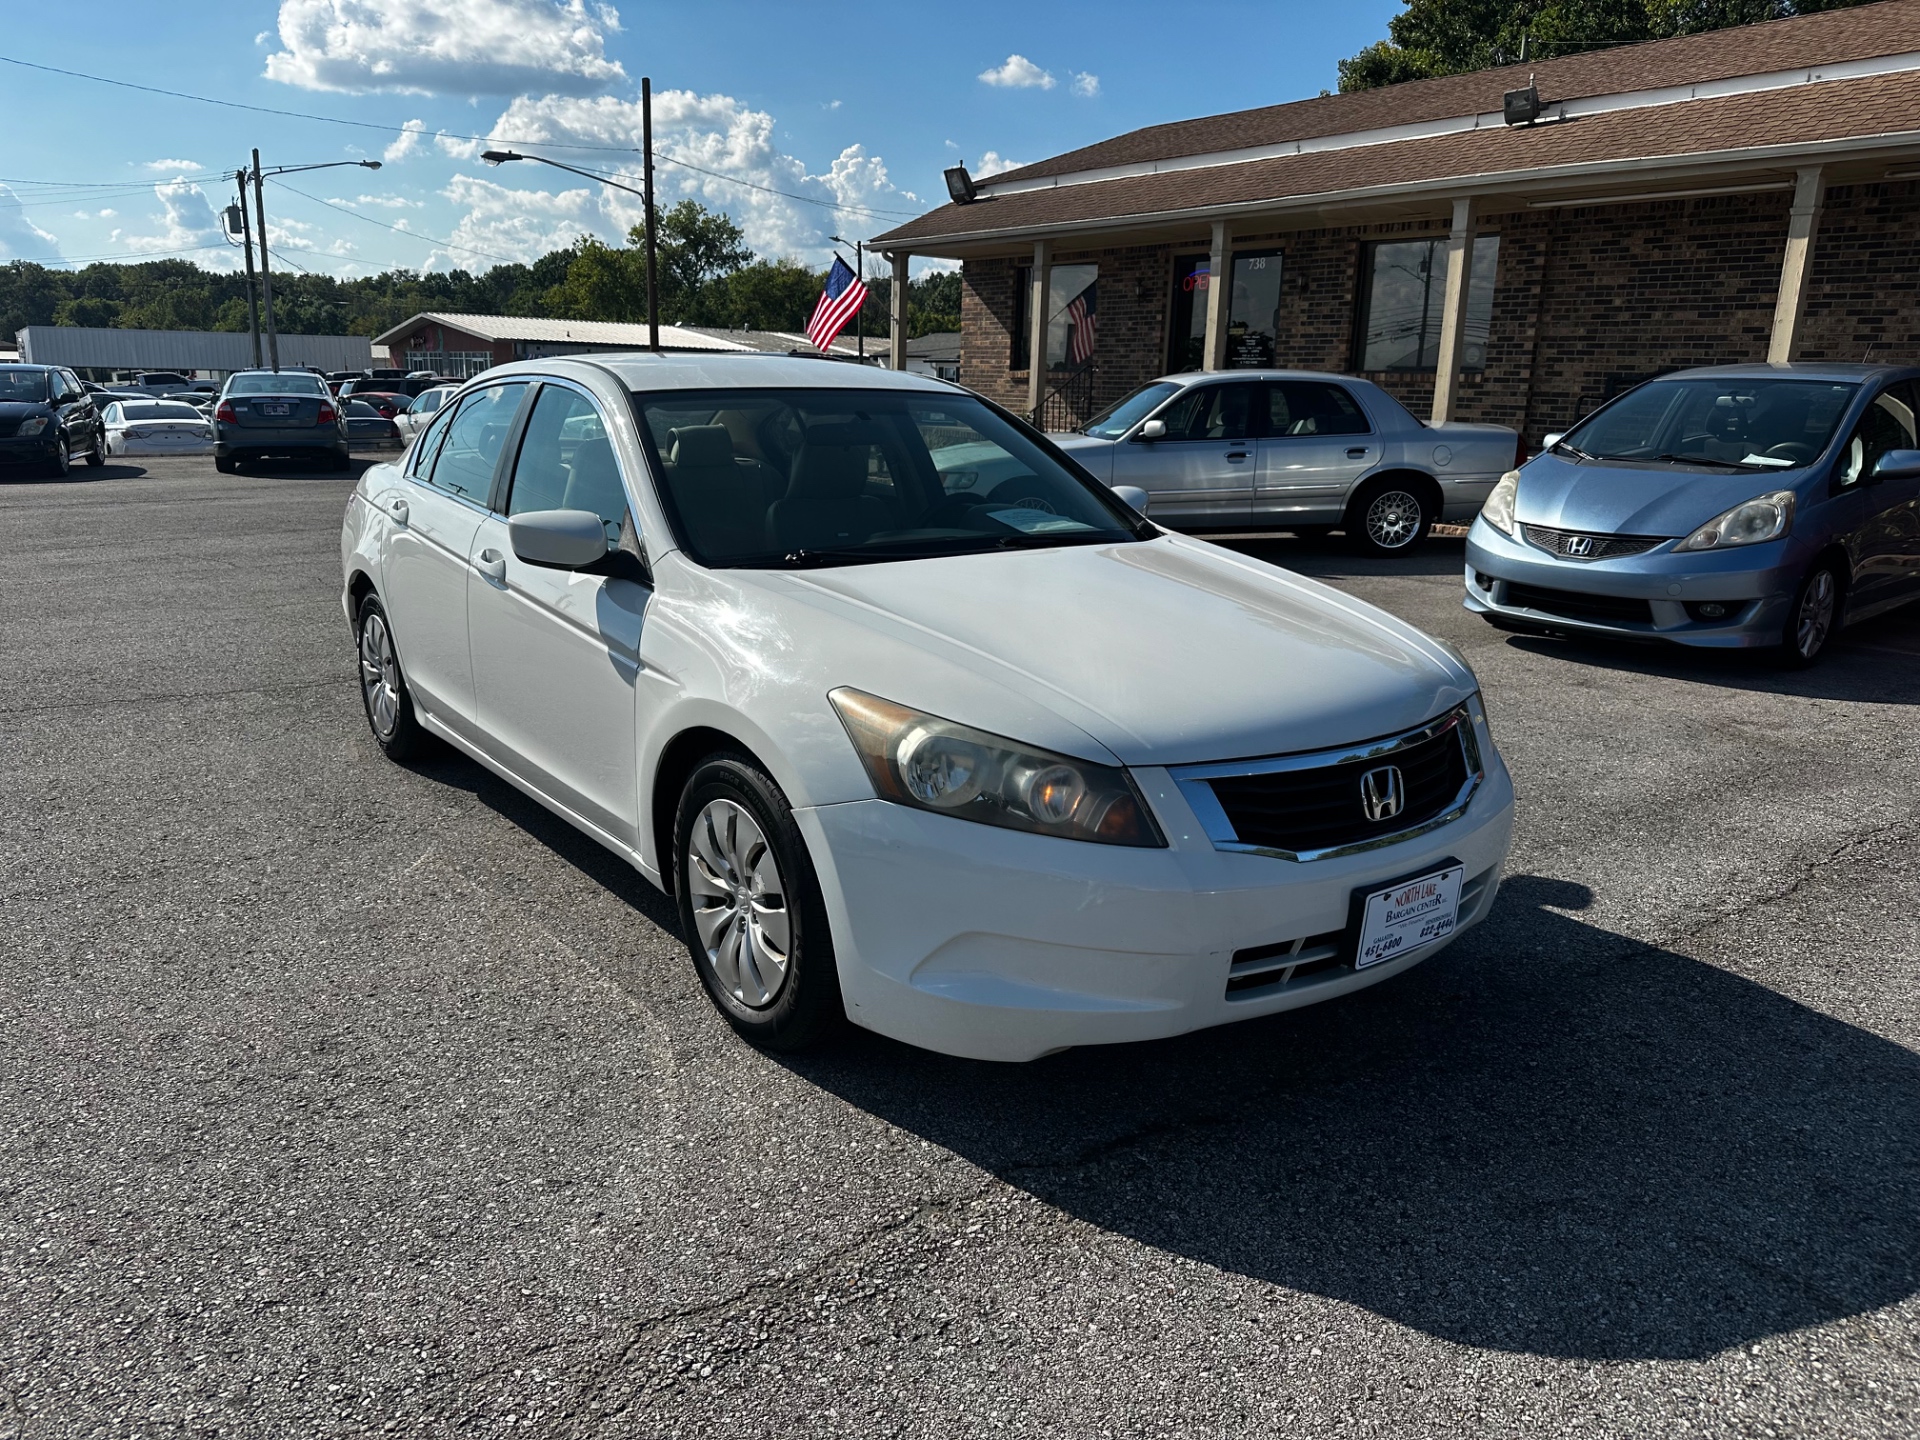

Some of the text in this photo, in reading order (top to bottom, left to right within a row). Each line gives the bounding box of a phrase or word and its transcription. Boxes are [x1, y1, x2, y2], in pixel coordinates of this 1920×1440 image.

[1248, 257, 1266, 270] 738
[719, 770, 774, 830] EDGE TOURING
[1386, 906, 1416, 923] BARGAIN
[1416, 893, 1442, 912] CENTER
[1395, 883, 1437, 908] NORTH LAKE
[1365, 936, 1402, 957] 451-6800
